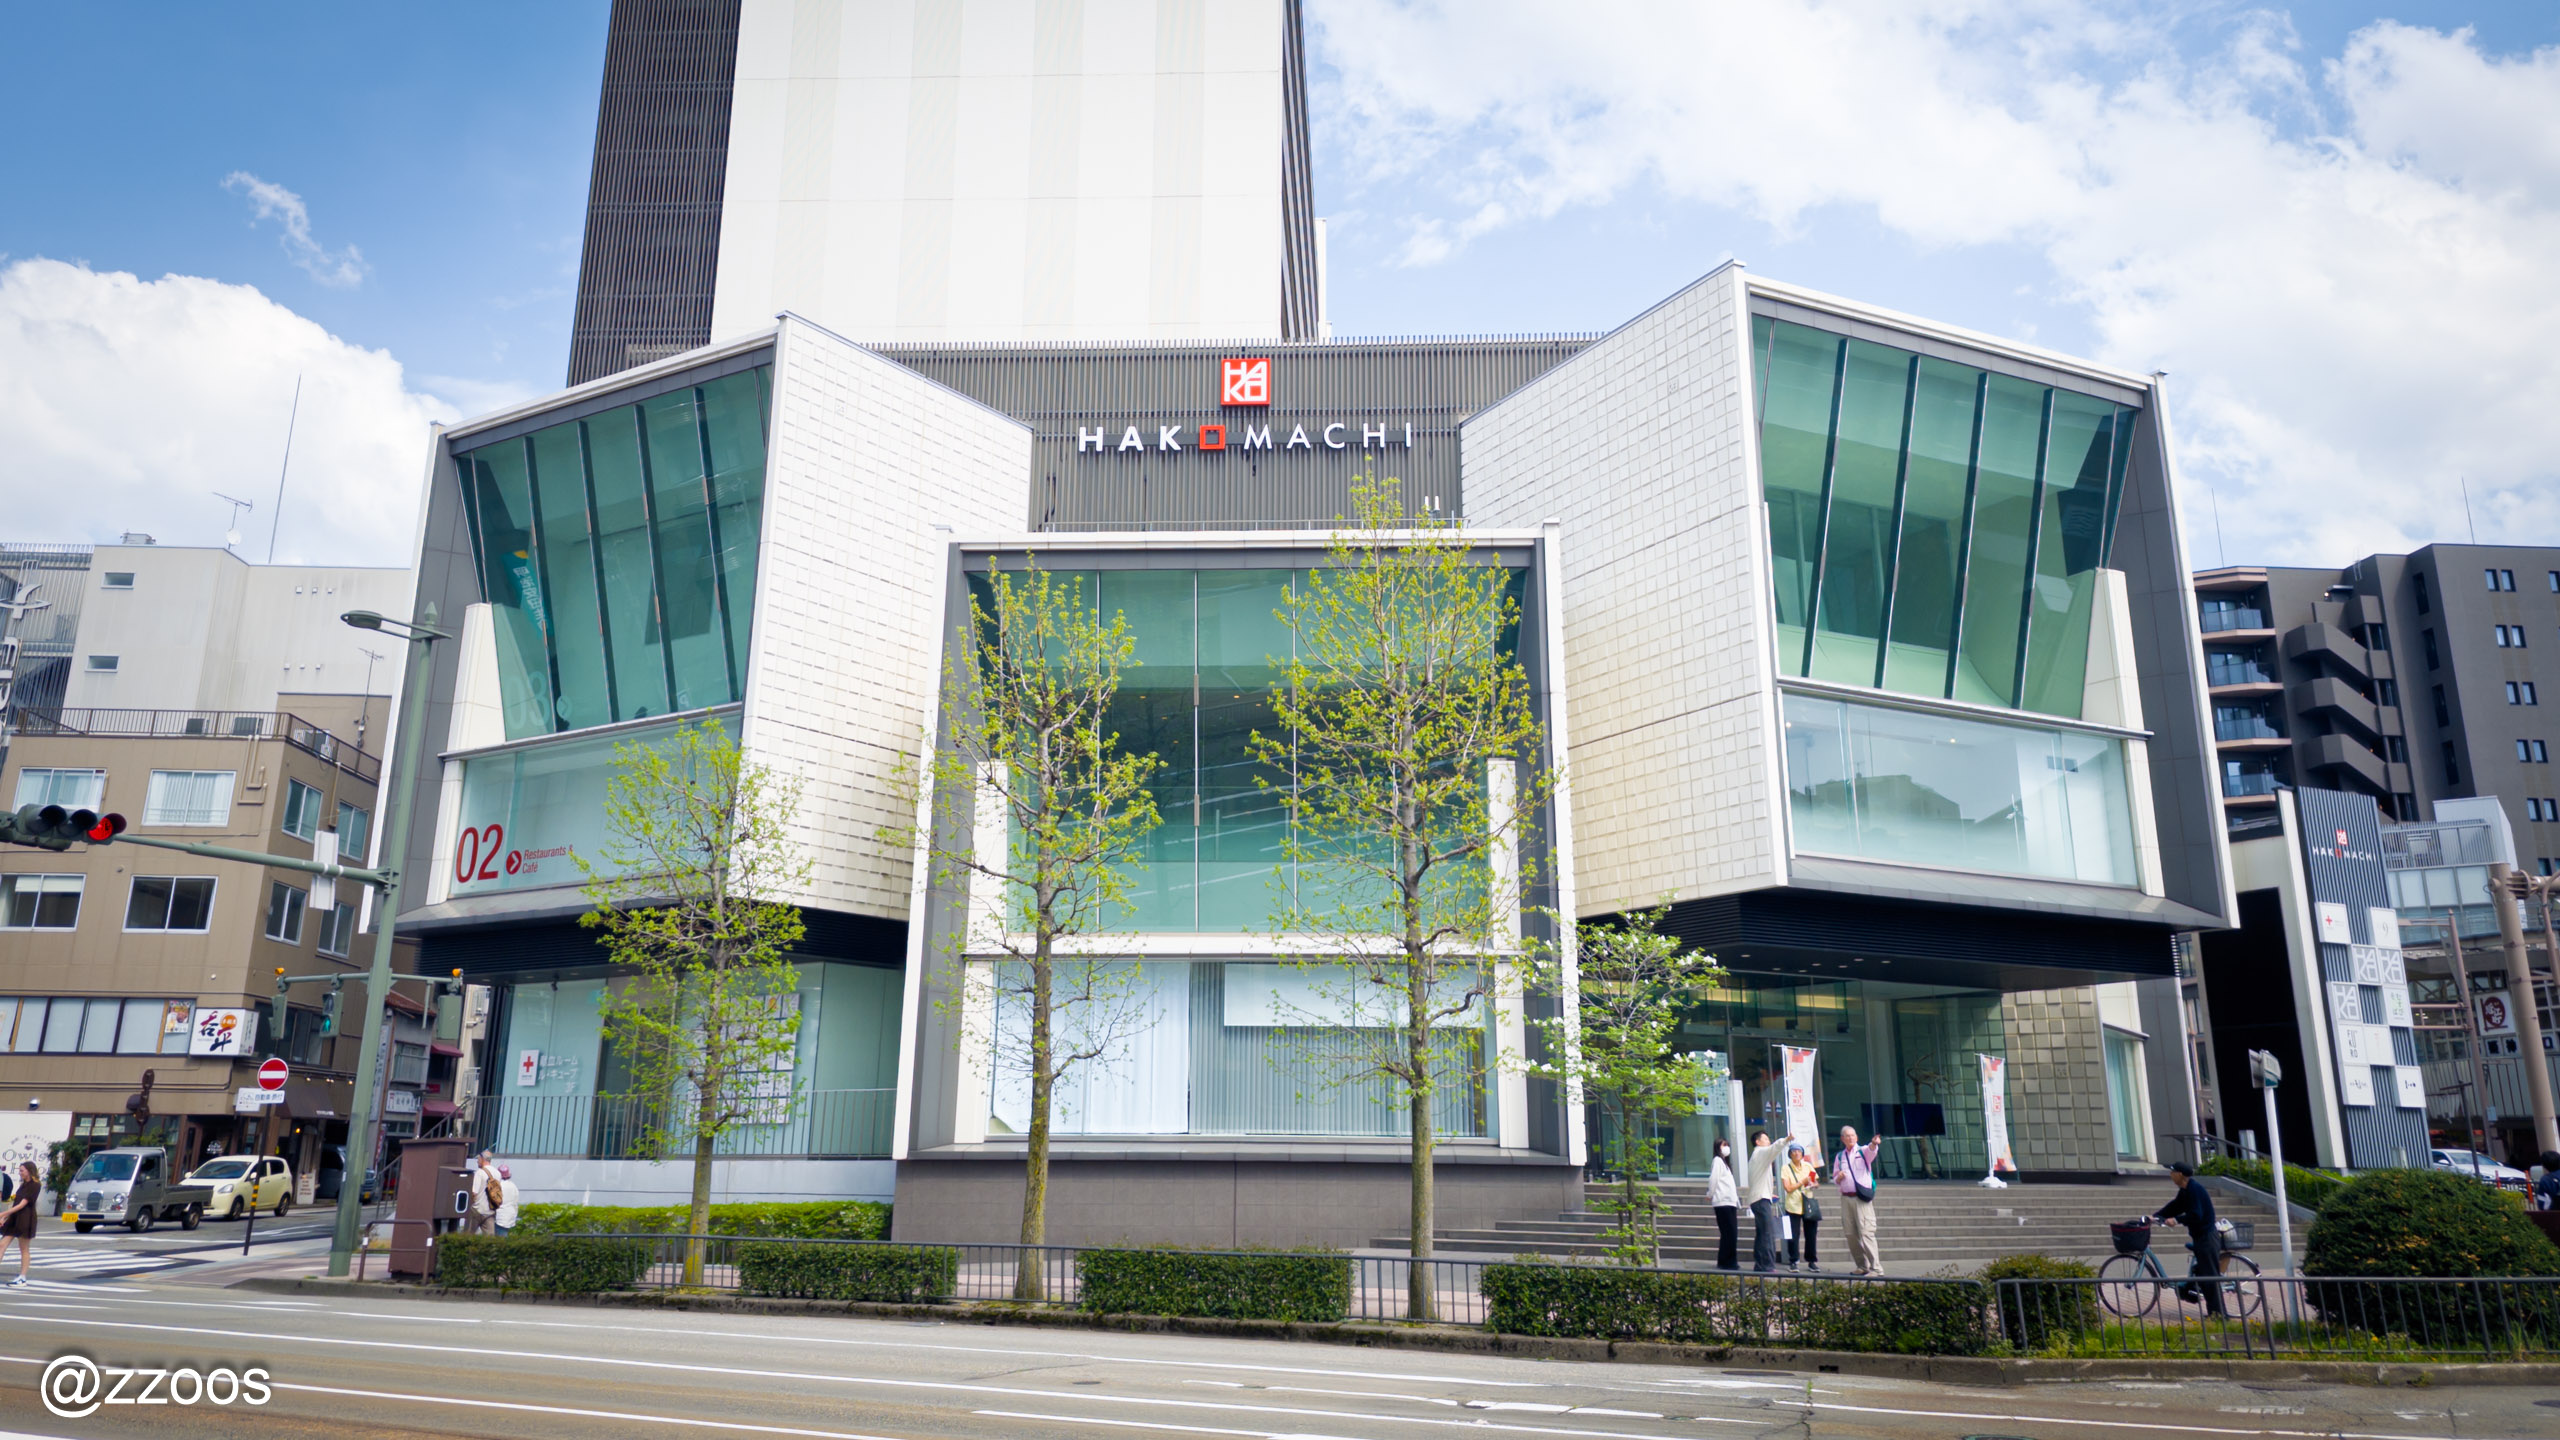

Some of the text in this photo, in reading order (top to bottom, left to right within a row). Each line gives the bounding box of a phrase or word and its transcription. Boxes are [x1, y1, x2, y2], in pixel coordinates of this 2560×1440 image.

[1079, 422, 1411, 451] HAKOMACHI
[456, 824, 503, 883] 02
[523, 846, 567, 860] Restaurants
[2312, 847, 2376, 862] HAKOMACHI
[522, 862, 538, 874] Café
